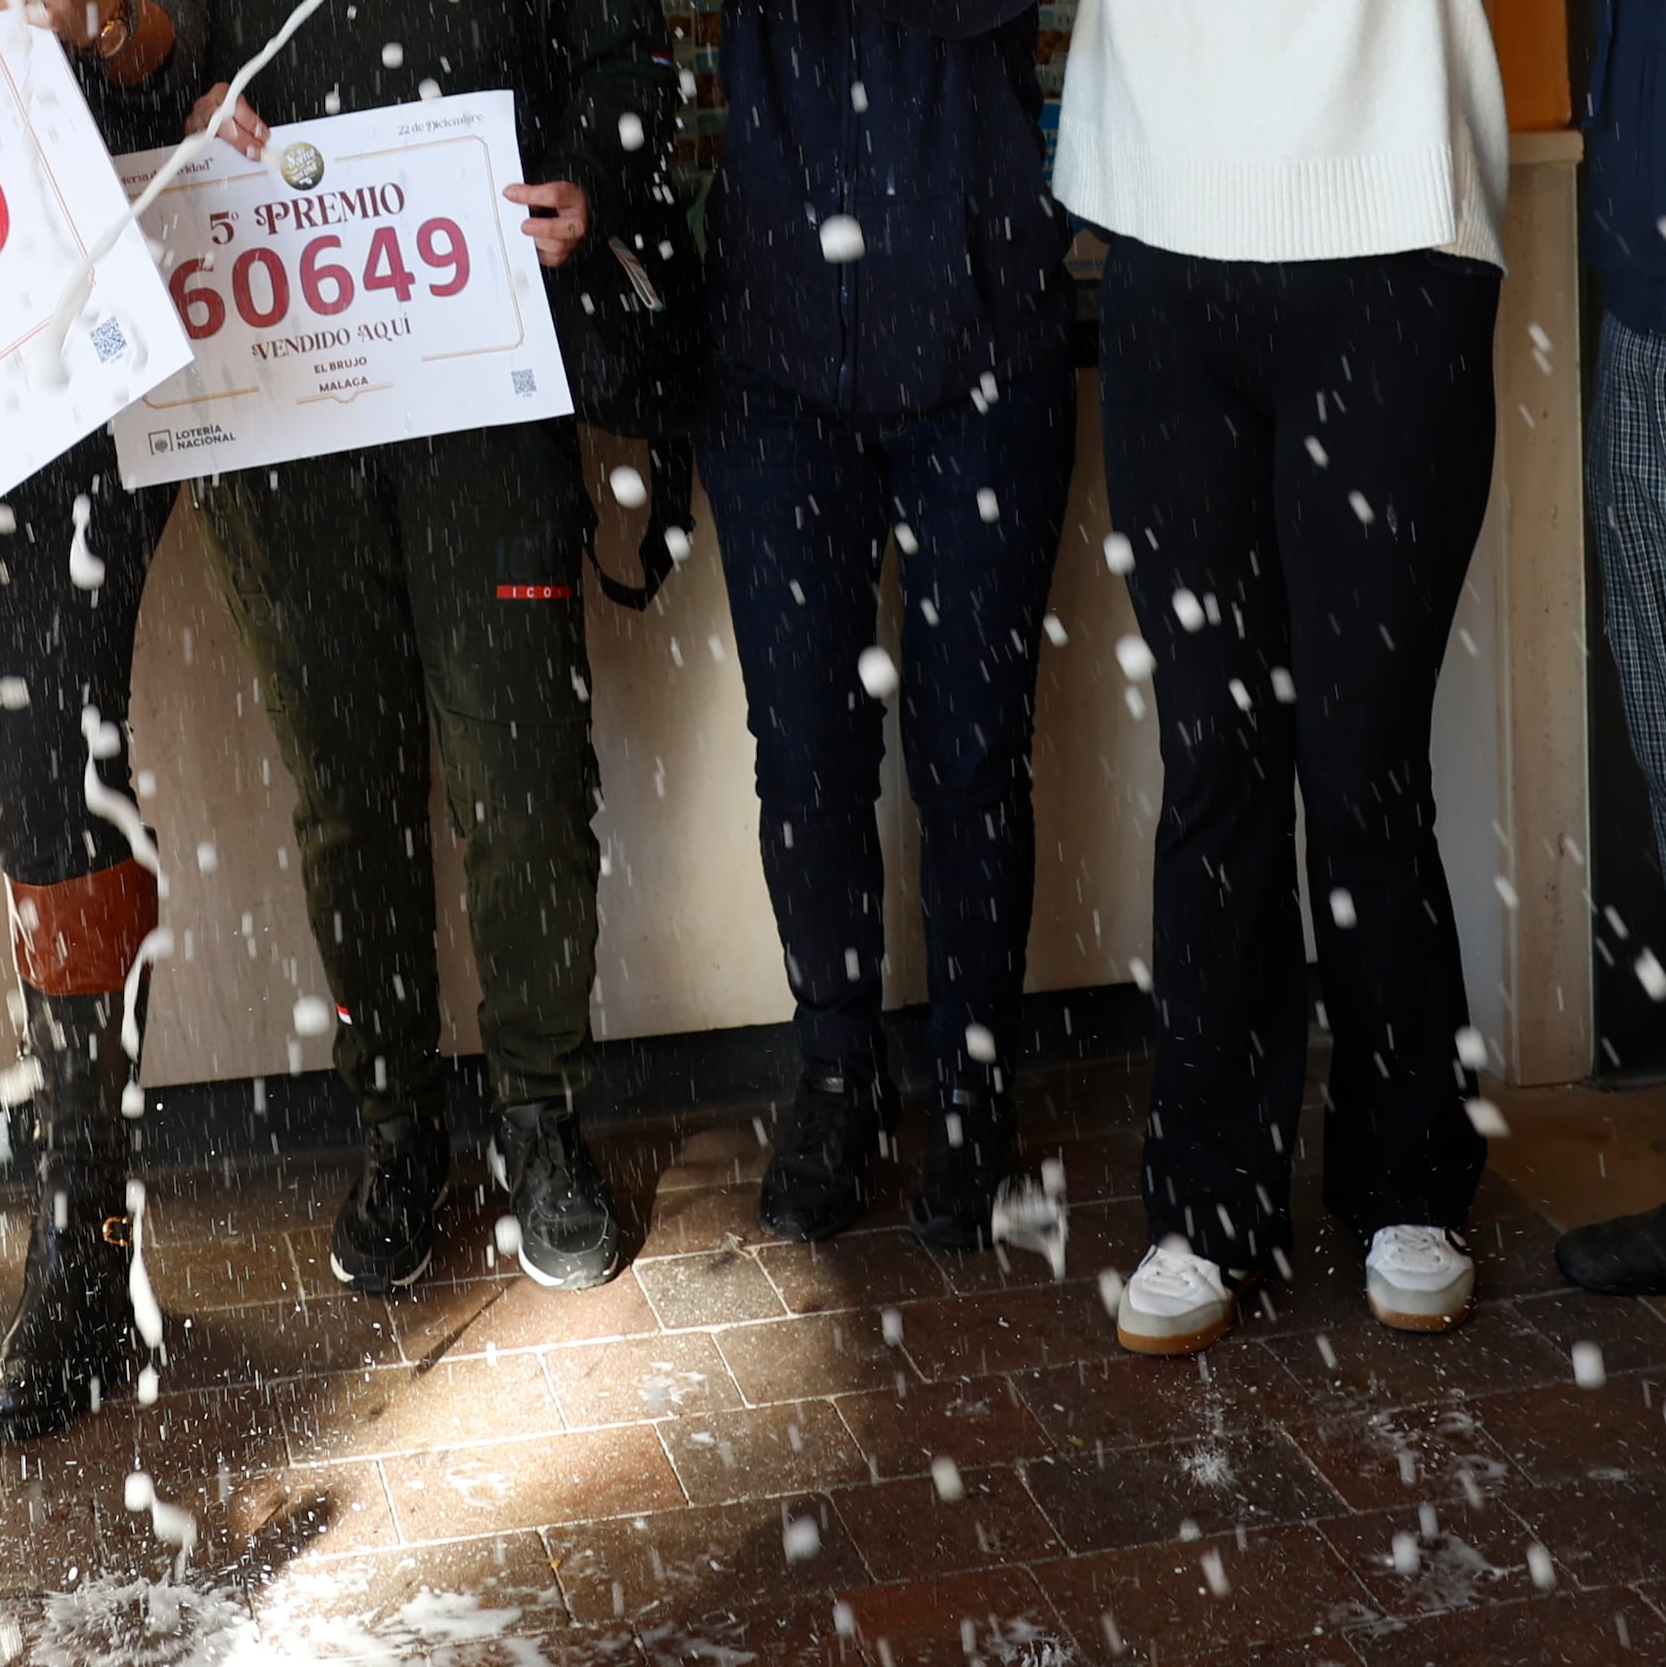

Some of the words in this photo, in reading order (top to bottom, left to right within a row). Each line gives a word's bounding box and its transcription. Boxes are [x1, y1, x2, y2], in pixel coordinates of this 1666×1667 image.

[398, 124, 411, 135] 22
[411, 123, 425, 134] de
[254, 182, 405, 235] PREMIO
[169, 217, 470, 341] 60649
[251, 327, 351, 361] VENDIDO
[357, 312, 413, 343] AQUÍ
[314, 363, 328, 374] EL
[329, 356, 368, 371] BRUJO
[319, 375, 369, 393] MALAGA
[175, 423, 223, 440] LOTERÍA
[177, 432, 236, 451] NACIONAL
